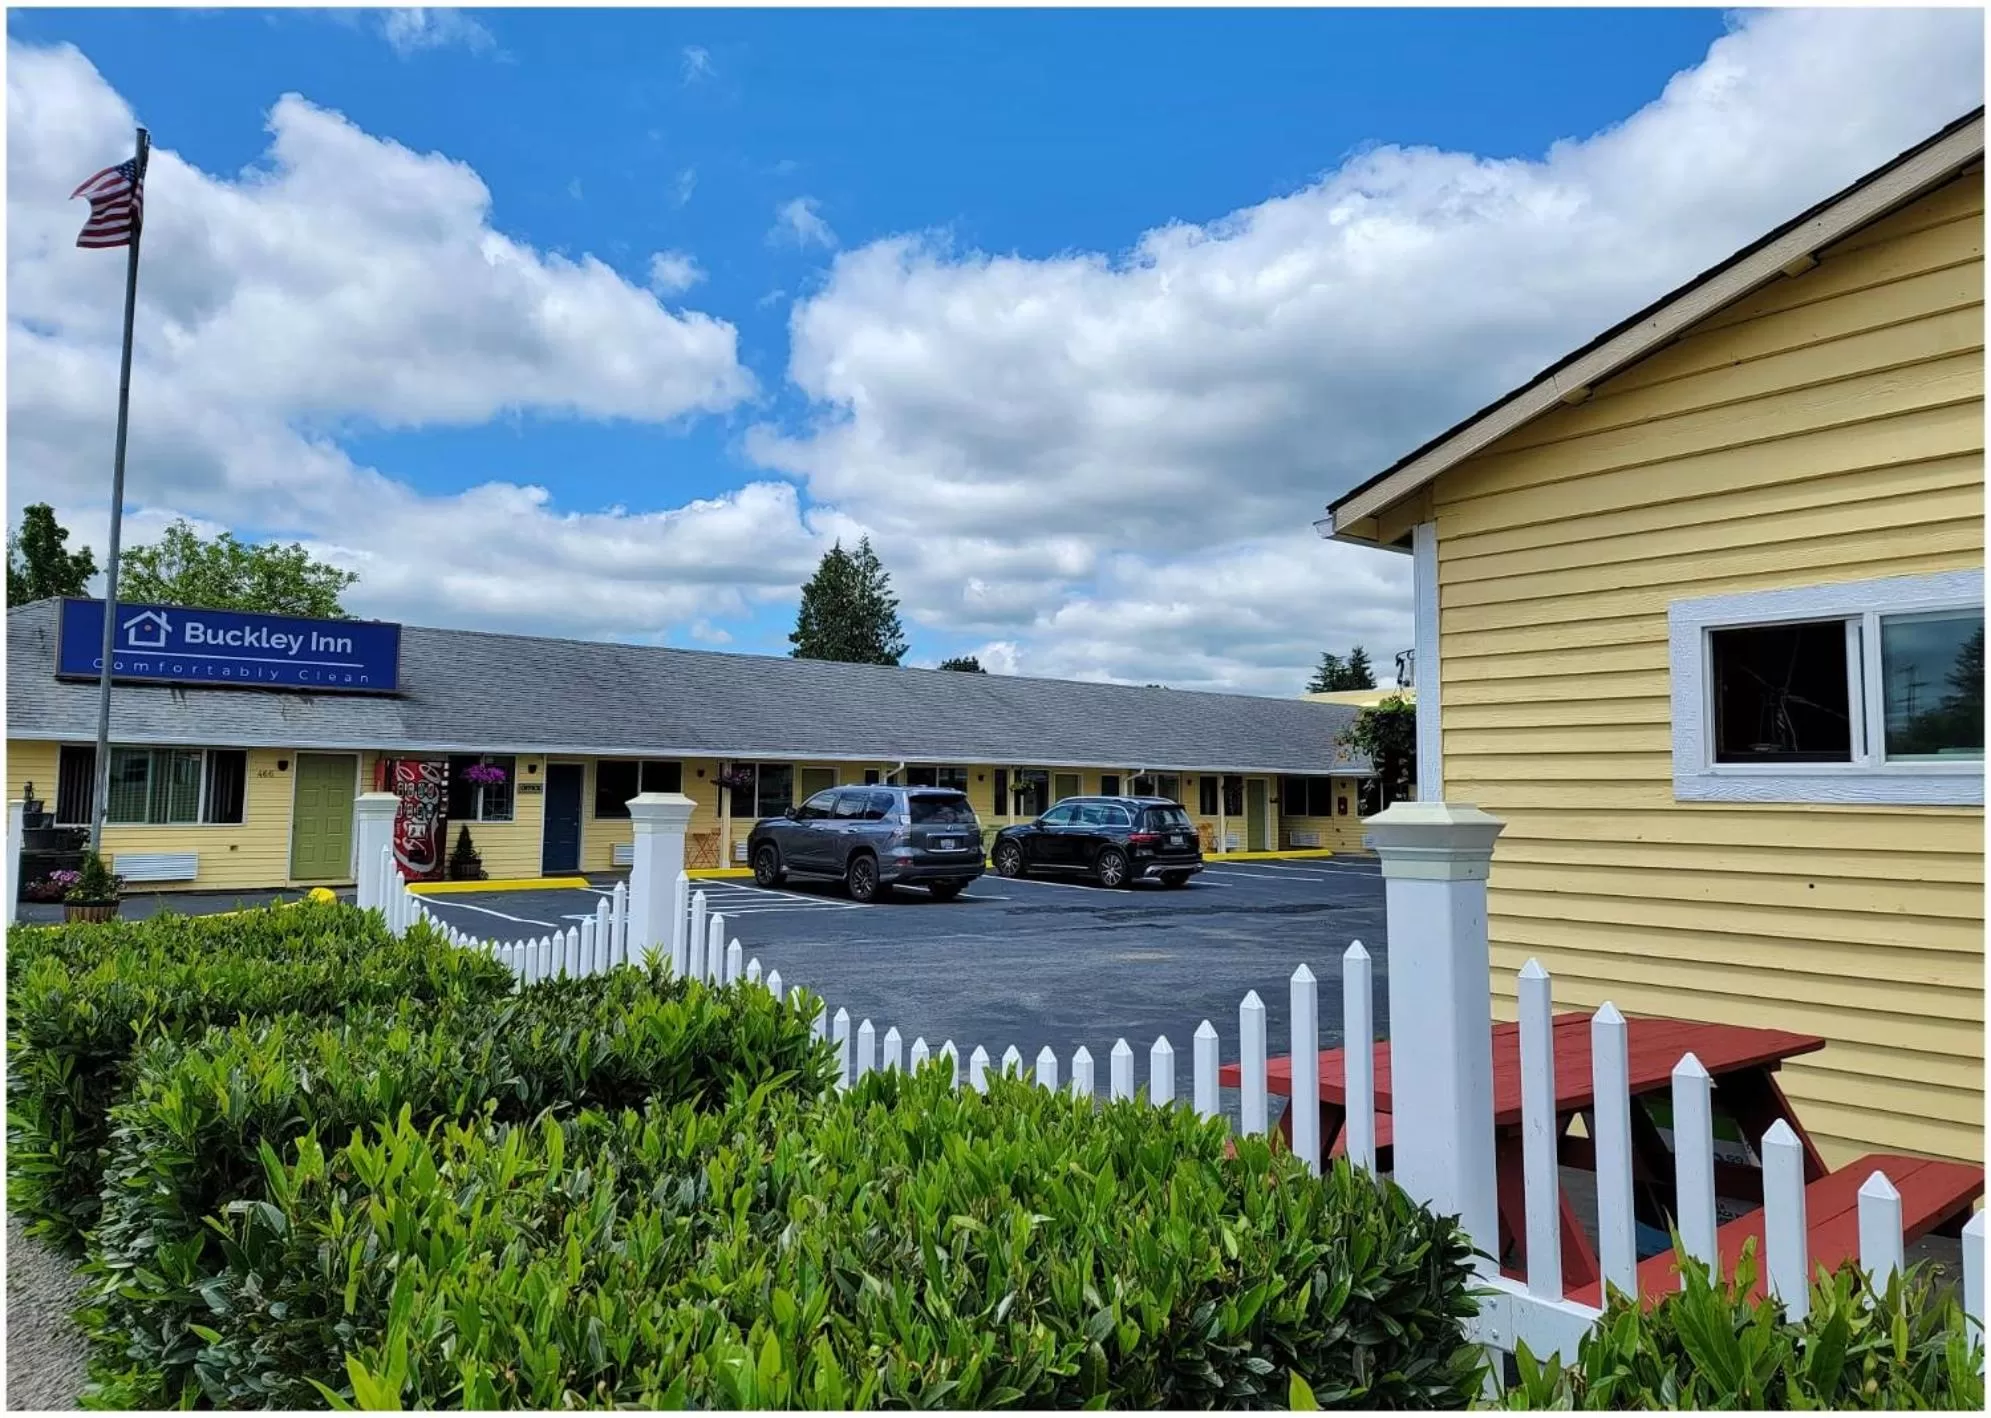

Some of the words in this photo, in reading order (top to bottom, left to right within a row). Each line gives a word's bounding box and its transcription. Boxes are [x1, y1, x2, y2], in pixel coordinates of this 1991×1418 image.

[184, 621, 304, 656] Buckley
[311, 631, 352, 653] Inn
[92, 657, 279, 681] Comfortably
[298, 669, 369, 683] Clean
